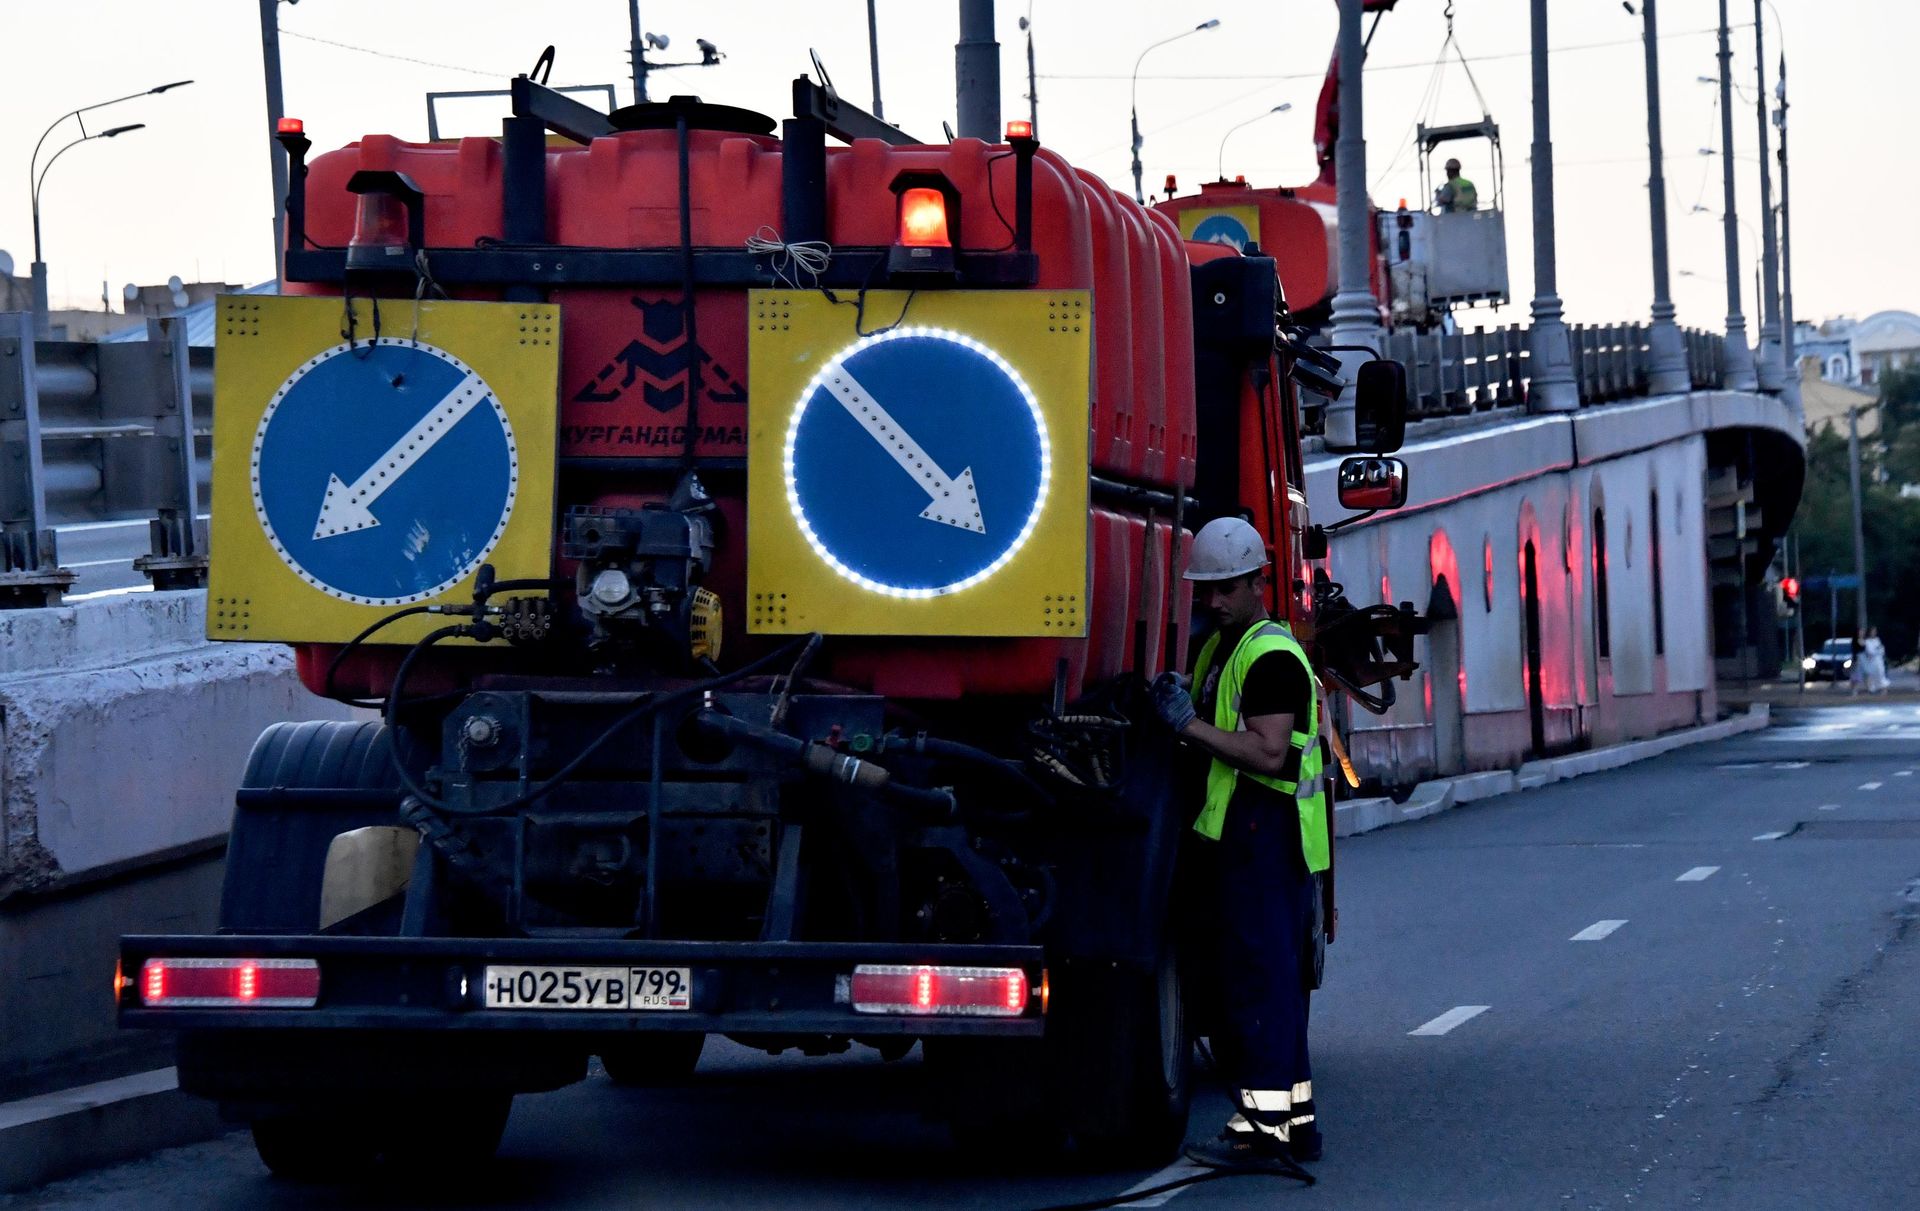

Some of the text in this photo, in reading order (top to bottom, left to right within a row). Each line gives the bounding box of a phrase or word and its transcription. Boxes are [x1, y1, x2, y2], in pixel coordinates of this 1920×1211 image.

[561, 425, 748, 447] КУРГАНДОРМА
[632, 969, 681, 996] 799
[643, 995, 668, 1006] RUS
